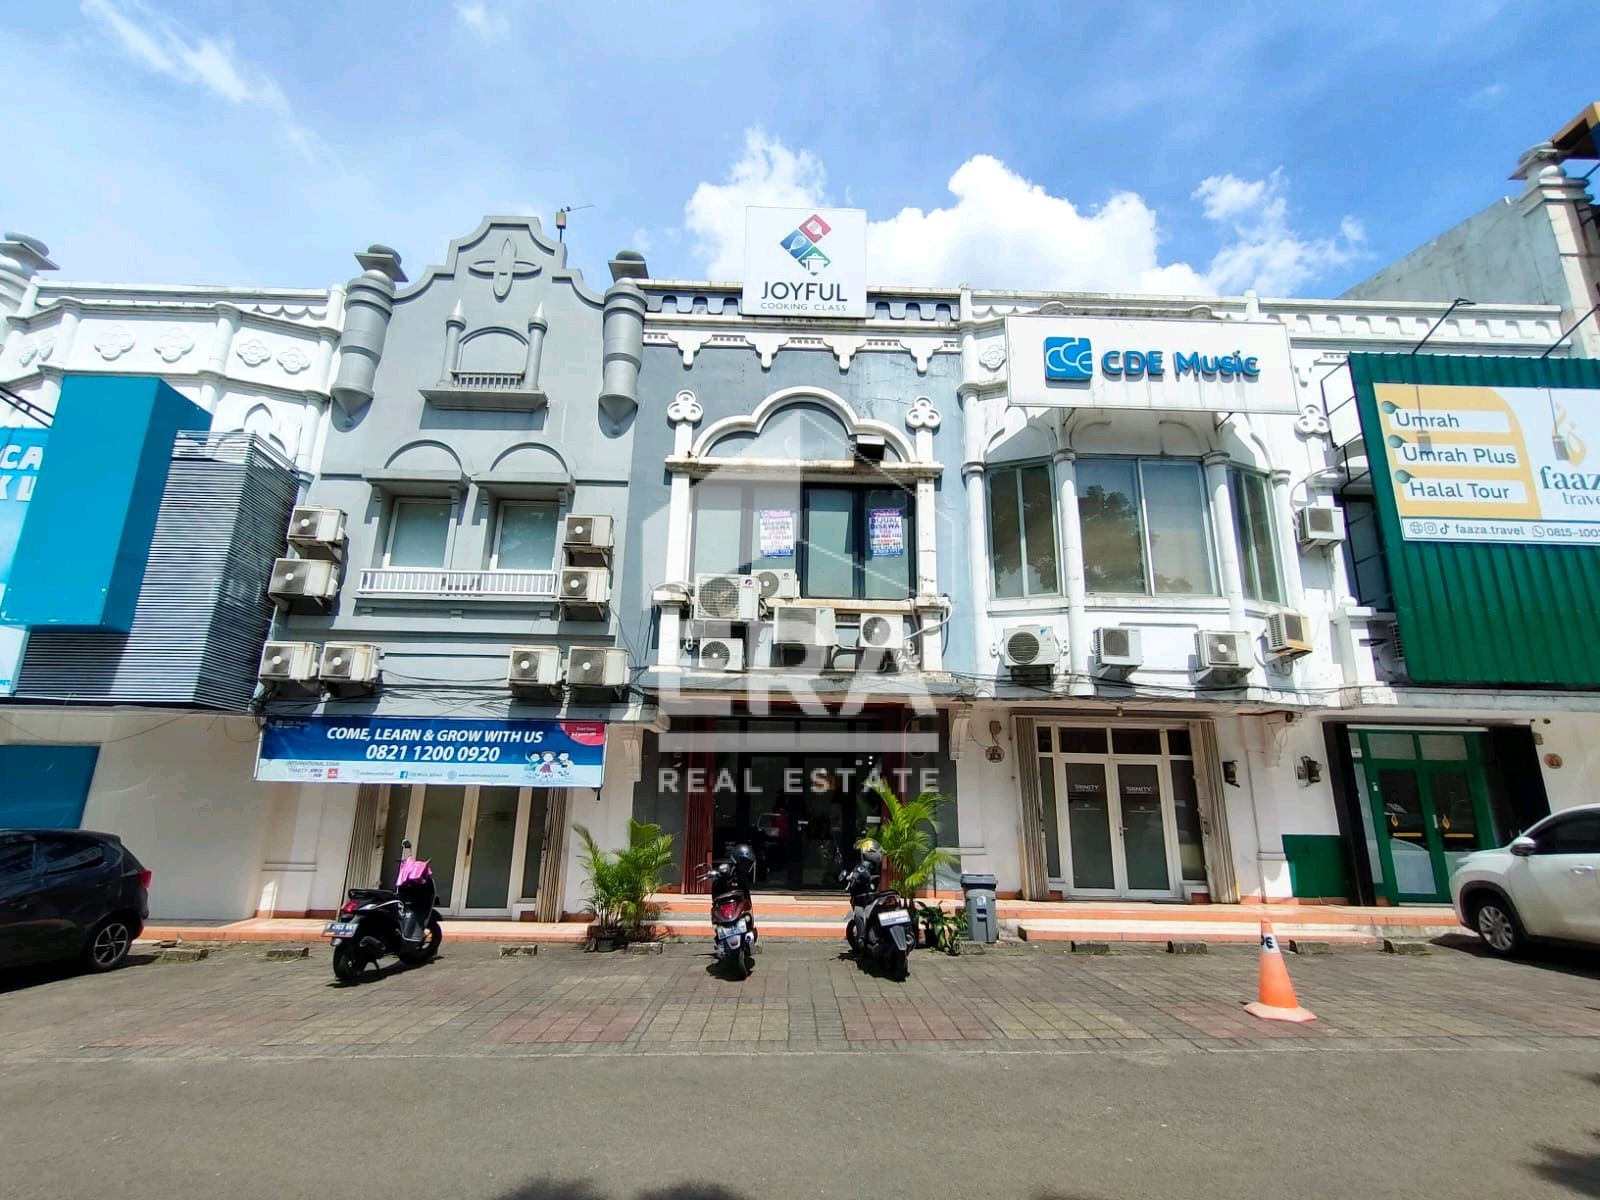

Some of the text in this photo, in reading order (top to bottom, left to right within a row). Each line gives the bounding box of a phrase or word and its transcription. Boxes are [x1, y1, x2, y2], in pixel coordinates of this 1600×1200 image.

[761, 281, 848, 302] JOYFUL
[760, 302, 847, 312] COOKING CLASS
[1101, 350, 1261, 377] CDE Music
[1395, 412, 1460, 428] Umrah
[0, 444, 44, 471] CA
[1402, 446, 1517, 464] Umrah Plus
[1410, 482, 1510, 499] Halal Tour
[1455, 523, 1525, 536] faaza.travel
[1546, 527, 1600, 538] 0815-100
[327, 727, 544, 743] COME, LEARN & GROW WITH US
[366, 744, 500, 762] 0821 1200 0920
